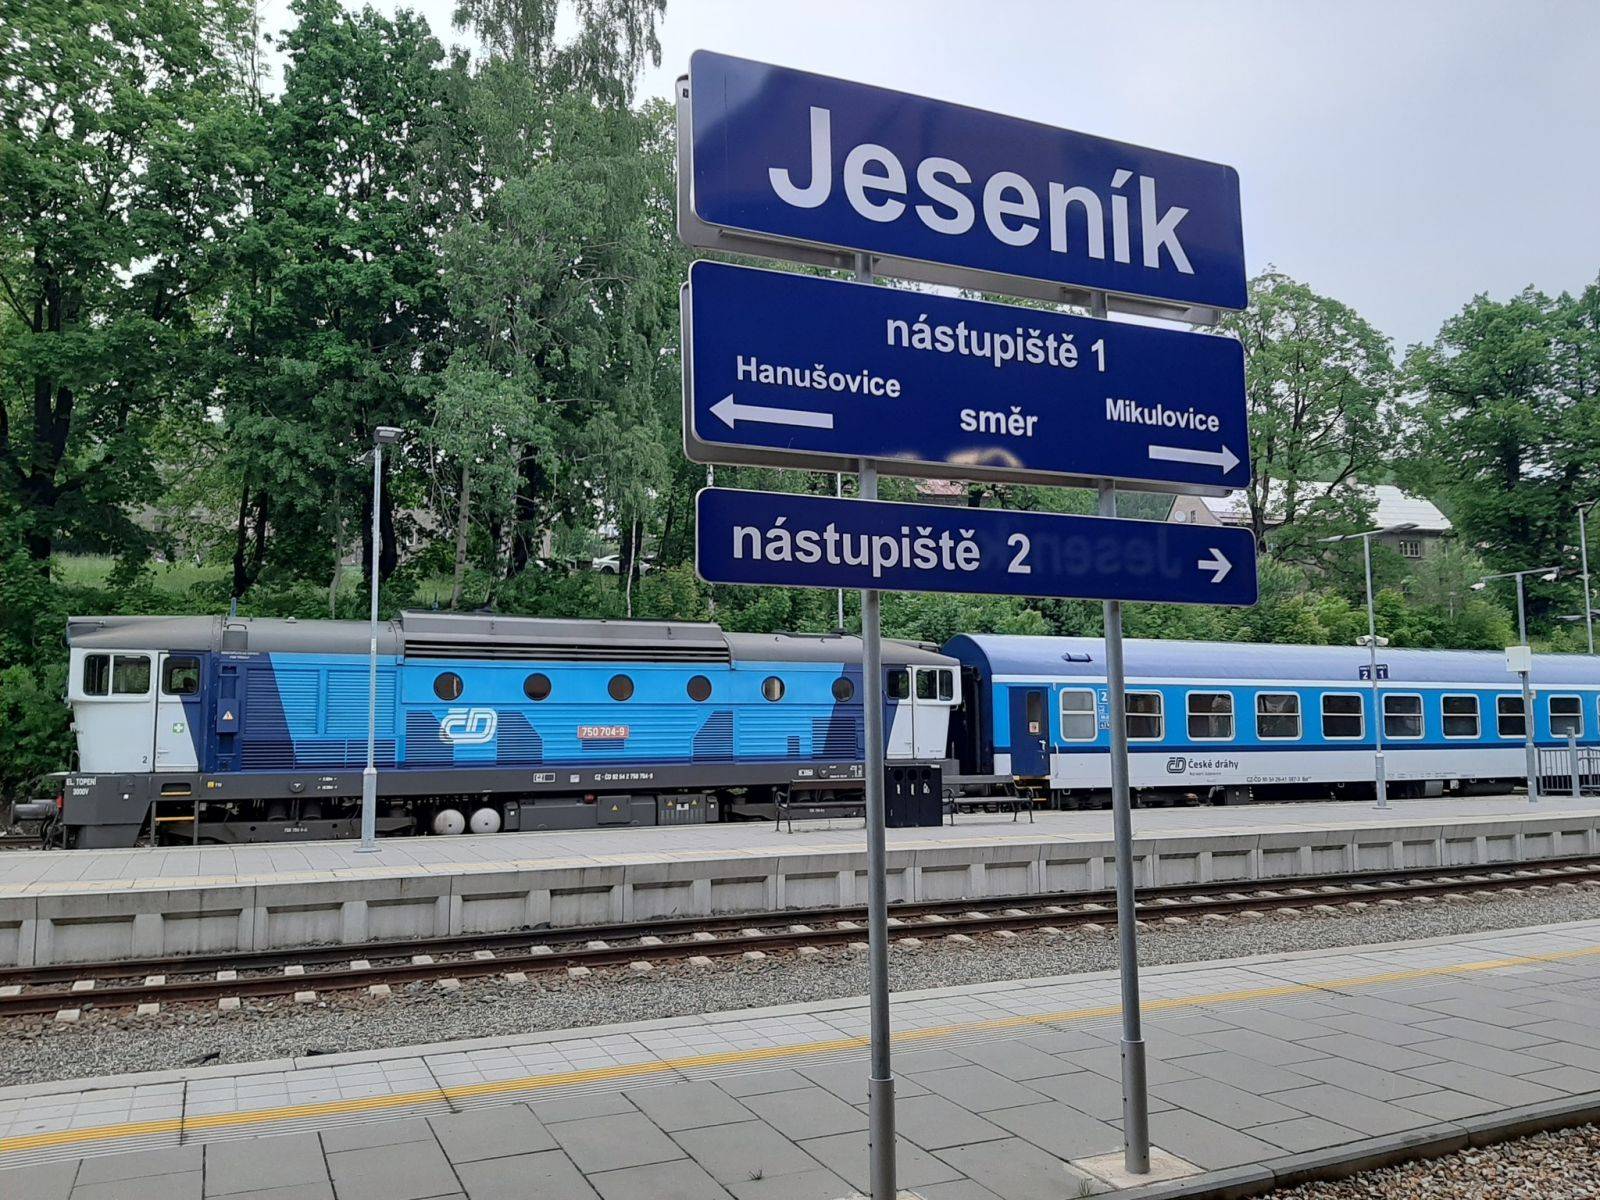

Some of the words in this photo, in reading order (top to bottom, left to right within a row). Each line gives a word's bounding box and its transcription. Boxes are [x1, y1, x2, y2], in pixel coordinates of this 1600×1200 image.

[768, 106, 1195, 276] Jeseník
[887, 313, 1078, 368] nástupiště
[1091, 338, 1105, 372] 1
[737, 355, 901, 398] Hanušovice
[960, 406, 1038, 437] směr
[1106, 398, 1219, 432] Mikulovice
[733, 516, 980, 578] nástupiště
[1007, 533, 1031, 574] 2
[1101, 691, 1108, 702] 2
[581, 727, 598, 737] 750
[600, 726, 624, 736] 704-9
[142, 755, 148, 764] 2
[1188, 758, 1212, 769] České
[1214, 759, 1238, 771] dráhy
